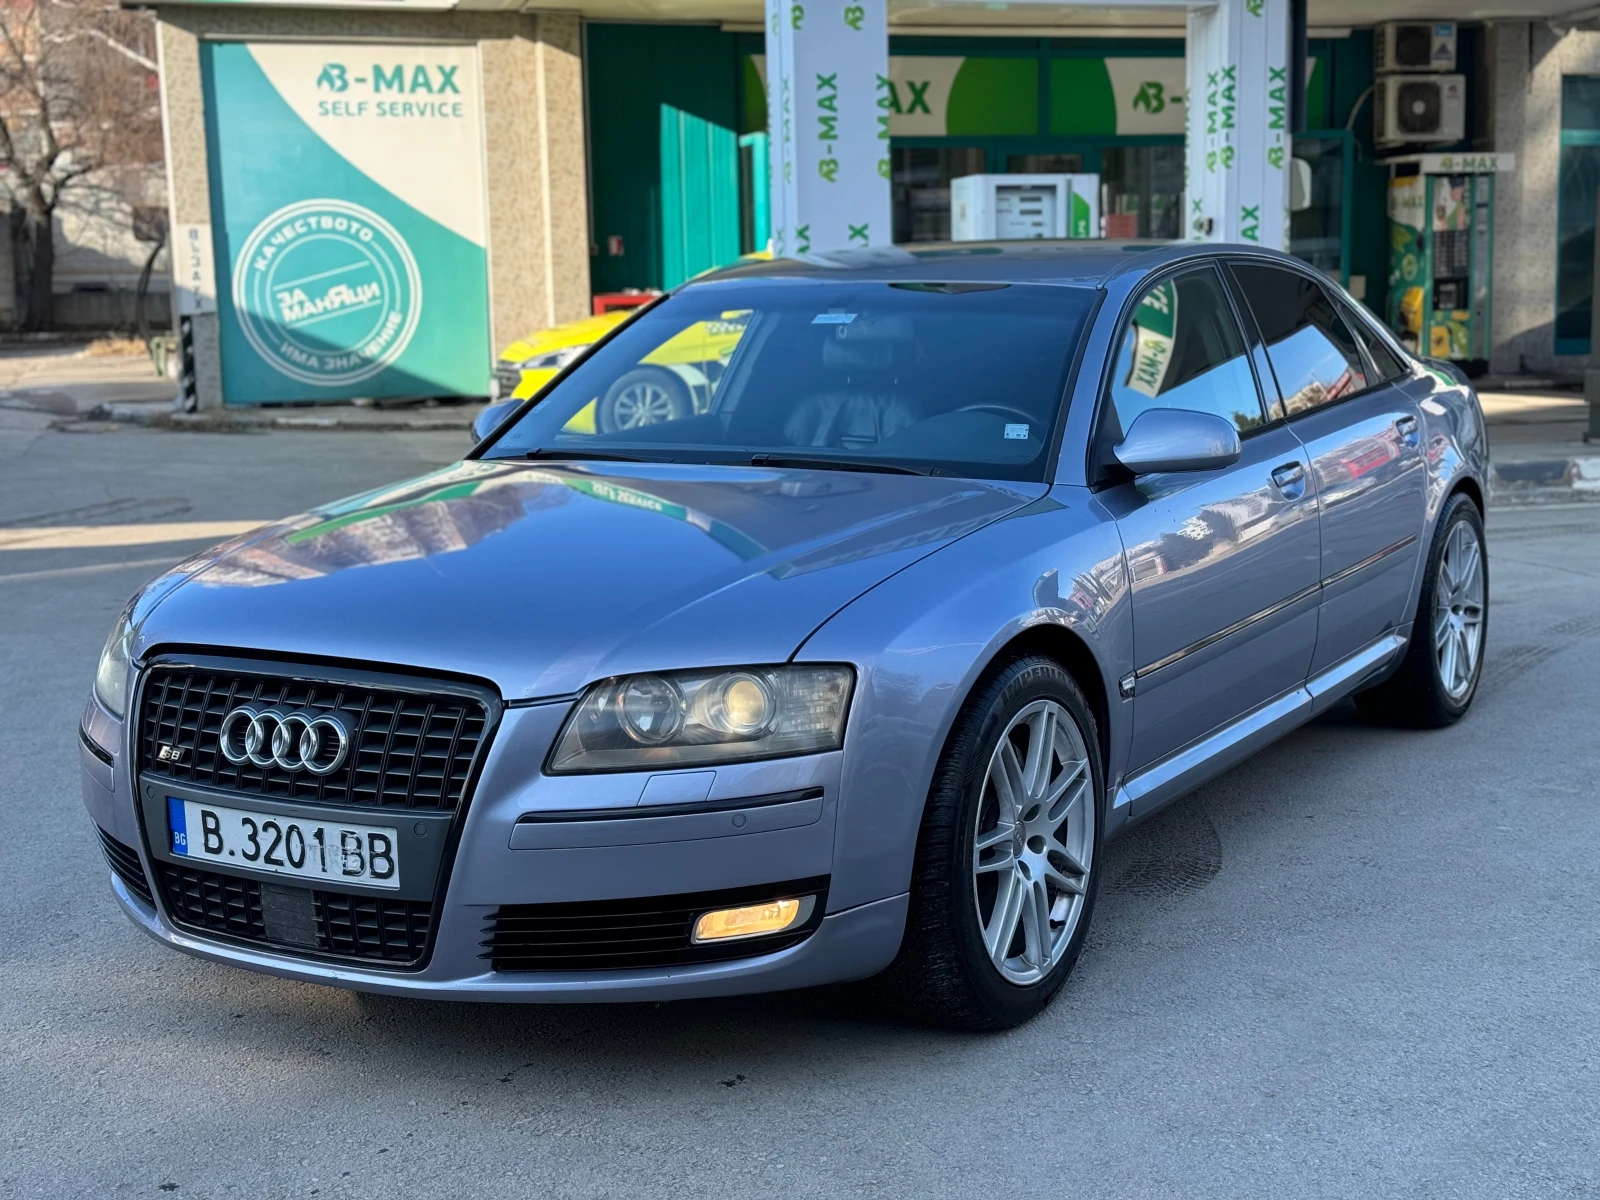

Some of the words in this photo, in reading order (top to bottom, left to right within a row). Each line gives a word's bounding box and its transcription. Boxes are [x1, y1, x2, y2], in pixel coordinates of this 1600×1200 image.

[318, 101, 368, 117] SELF
[376, 102, 464, 118] SERVICE
[253, 215, 374, 272] КАЧЕСТВОТО
[275, 288, 310, 309] ЗА
[279, 341, 319, 371] ИМА
[323, 310, 403, 371] ЗНАЧЕНИЕ
[174, 832, 186, 846] BG
